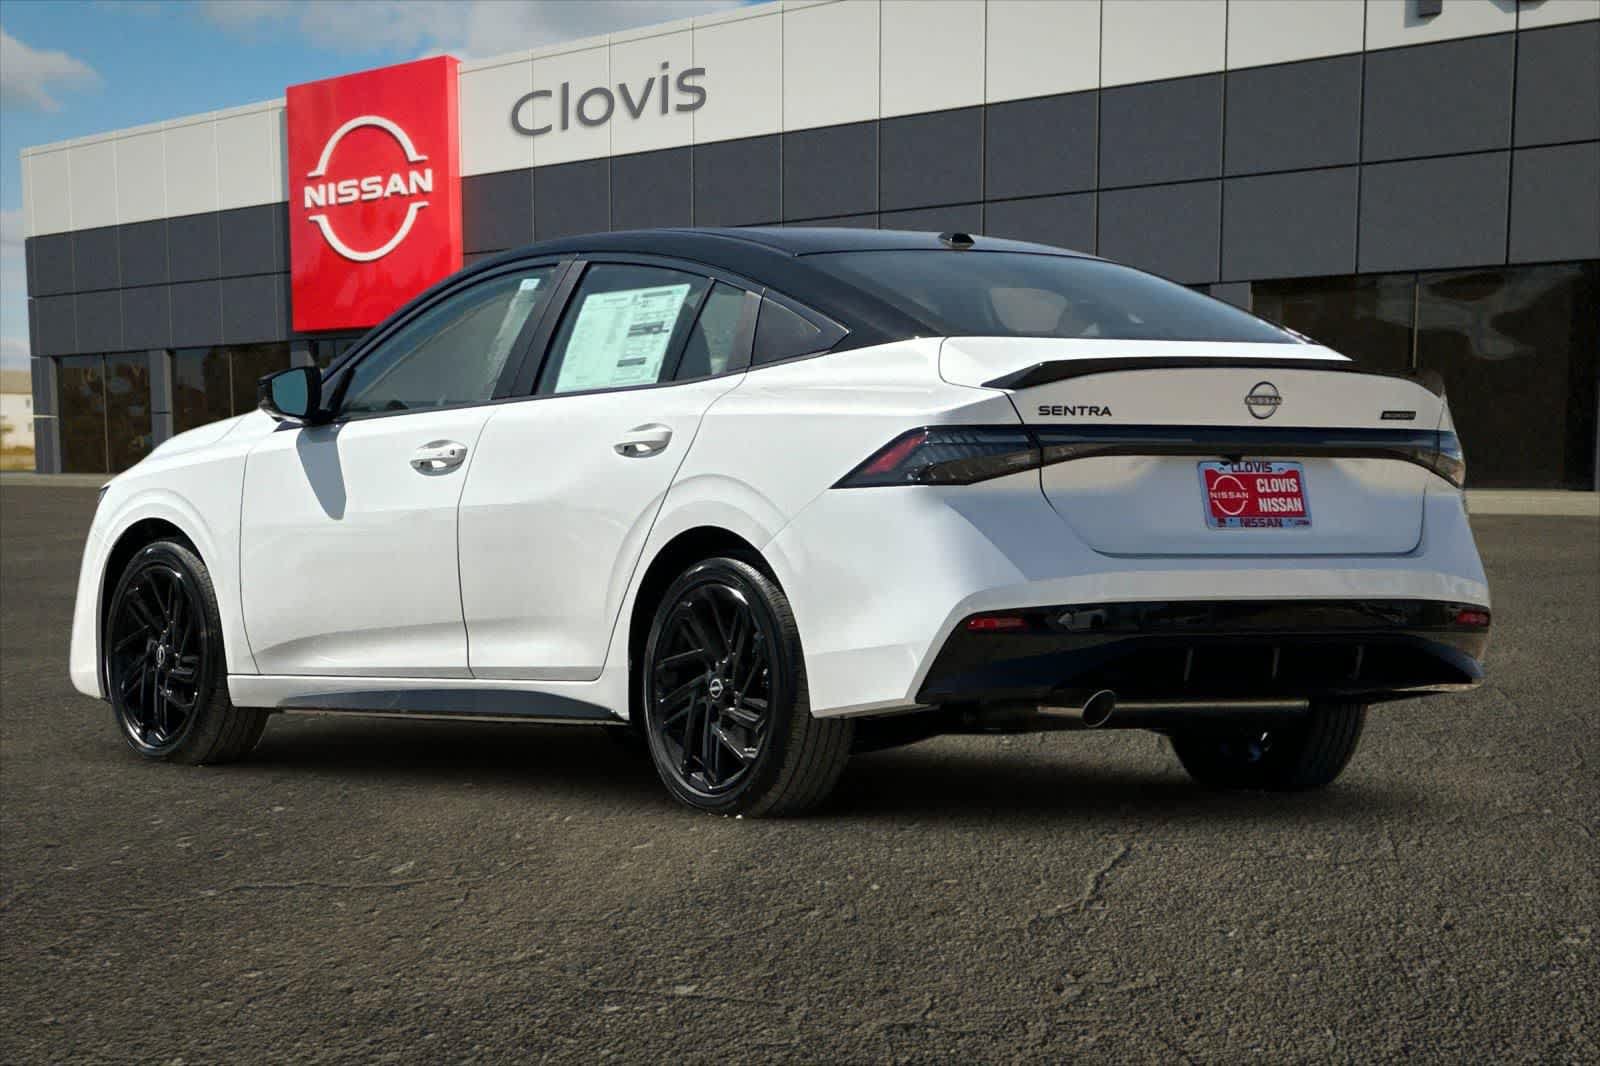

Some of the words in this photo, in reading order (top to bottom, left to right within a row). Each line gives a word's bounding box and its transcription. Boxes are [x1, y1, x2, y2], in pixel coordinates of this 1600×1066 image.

[511, 61, 707, 136] Clovis
[304, 168, 433, 209] NISSAN
[1038, 405, 1112, 416] SENTRA
[1257, 478, 1298, 493] CLOVIS
[1210, 491, 1249, 499] NISSAN
[1258, 497, 1303, 512] NISSAN
[1240, 518, 1283, 528] NISSAN
